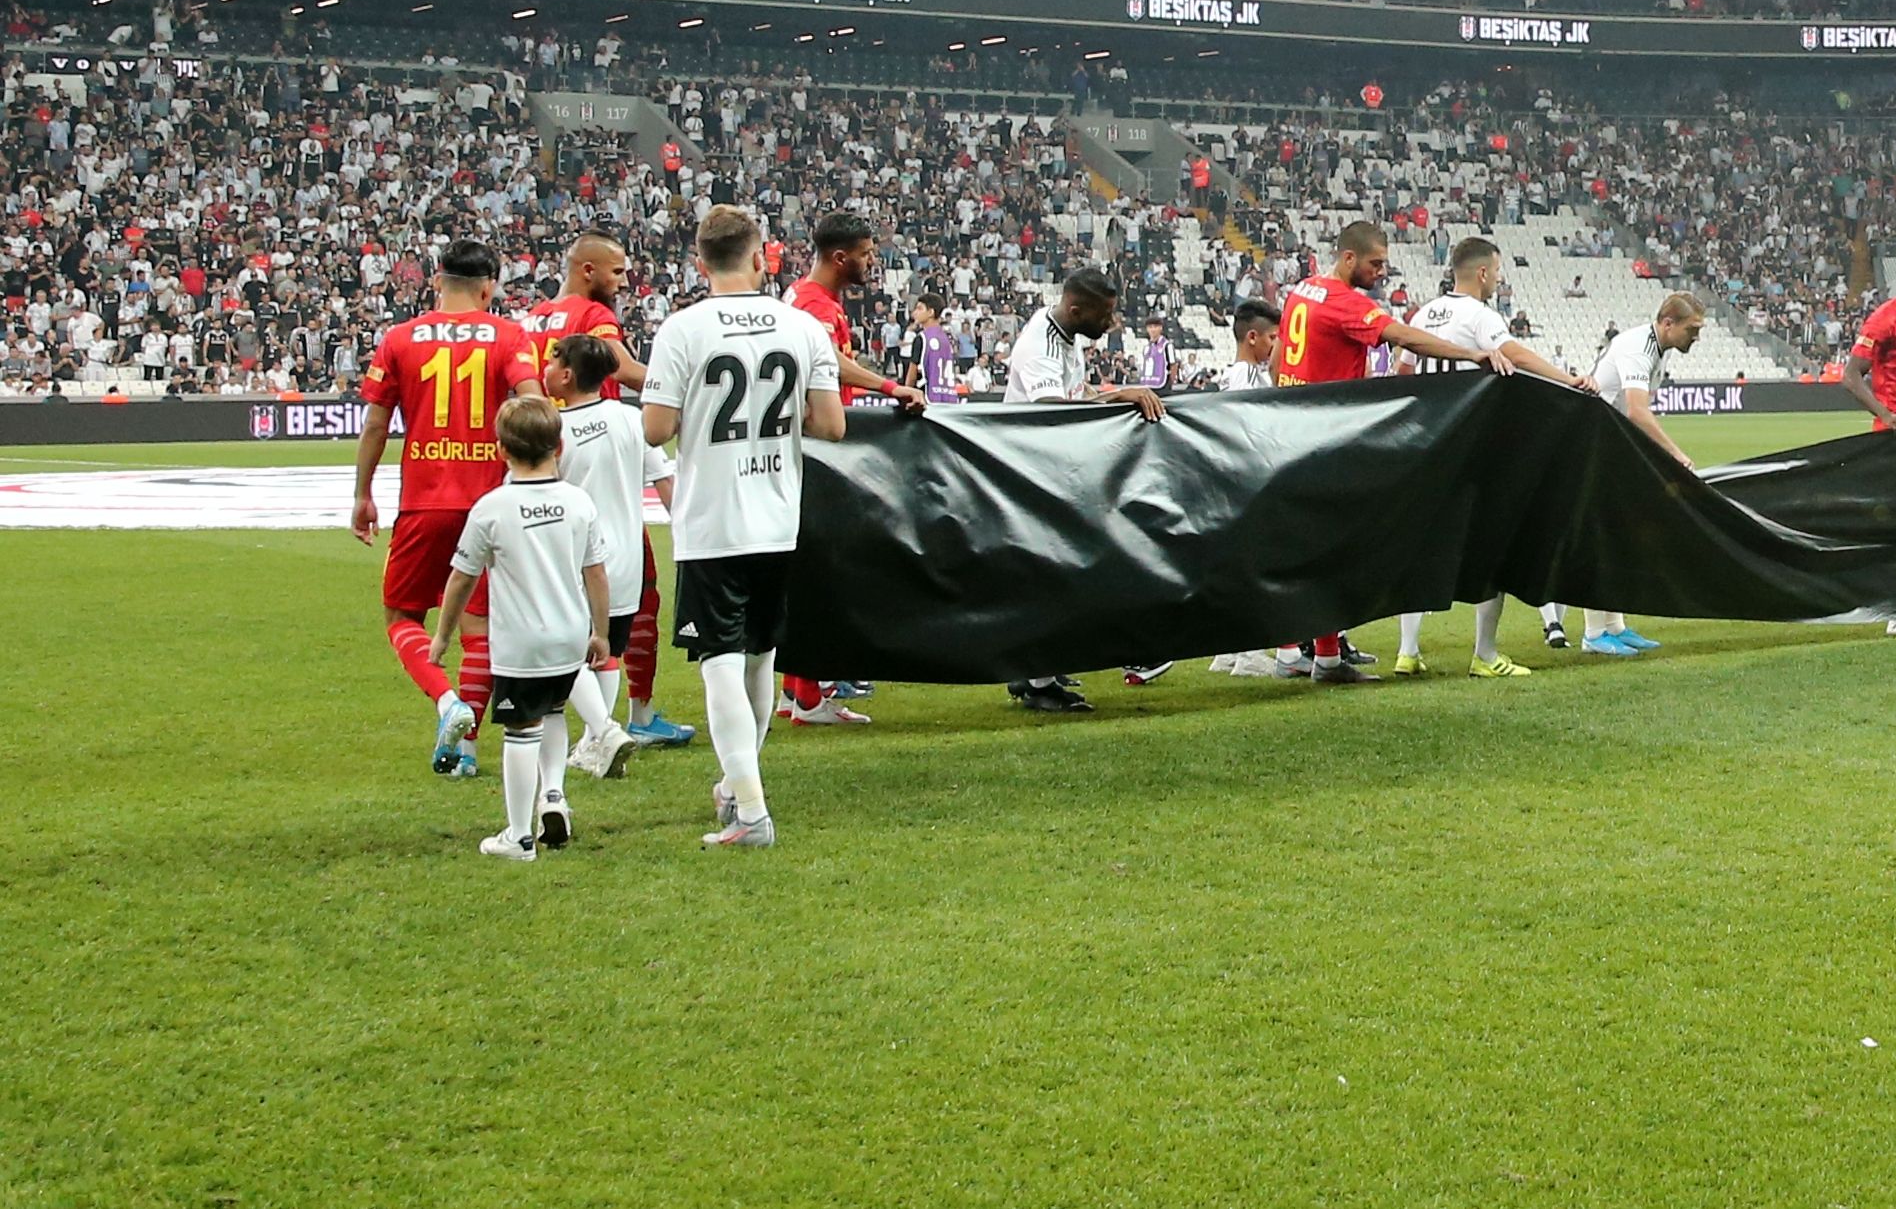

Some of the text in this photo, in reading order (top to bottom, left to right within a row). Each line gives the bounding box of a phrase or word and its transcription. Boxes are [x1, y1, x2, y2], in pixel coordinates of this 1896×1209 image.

[1236, 2, 1260, 24] JK
[1479, 17, 1590, 47] BEŞİKTAŞ JK
[606, 107, 629, 120] 117
[412, 322, 497, 343] aksa
[717, 310, 776, 328] beko
[1285, 302, 1308, 366] 9
[938, 358, 955, 387] 14
[420, 347, 487, 429] 11
[704, 349, 797, 446] 22
[1650, 386, 1743, 416] ŞİKTAŞ JK
[571, 418, 608, 438] beko
[411, 437, 497, 462] S.GÜRLER
[738, 447, 782, 477] LJAJIĆ
[519, 503, 565, 520] beko
